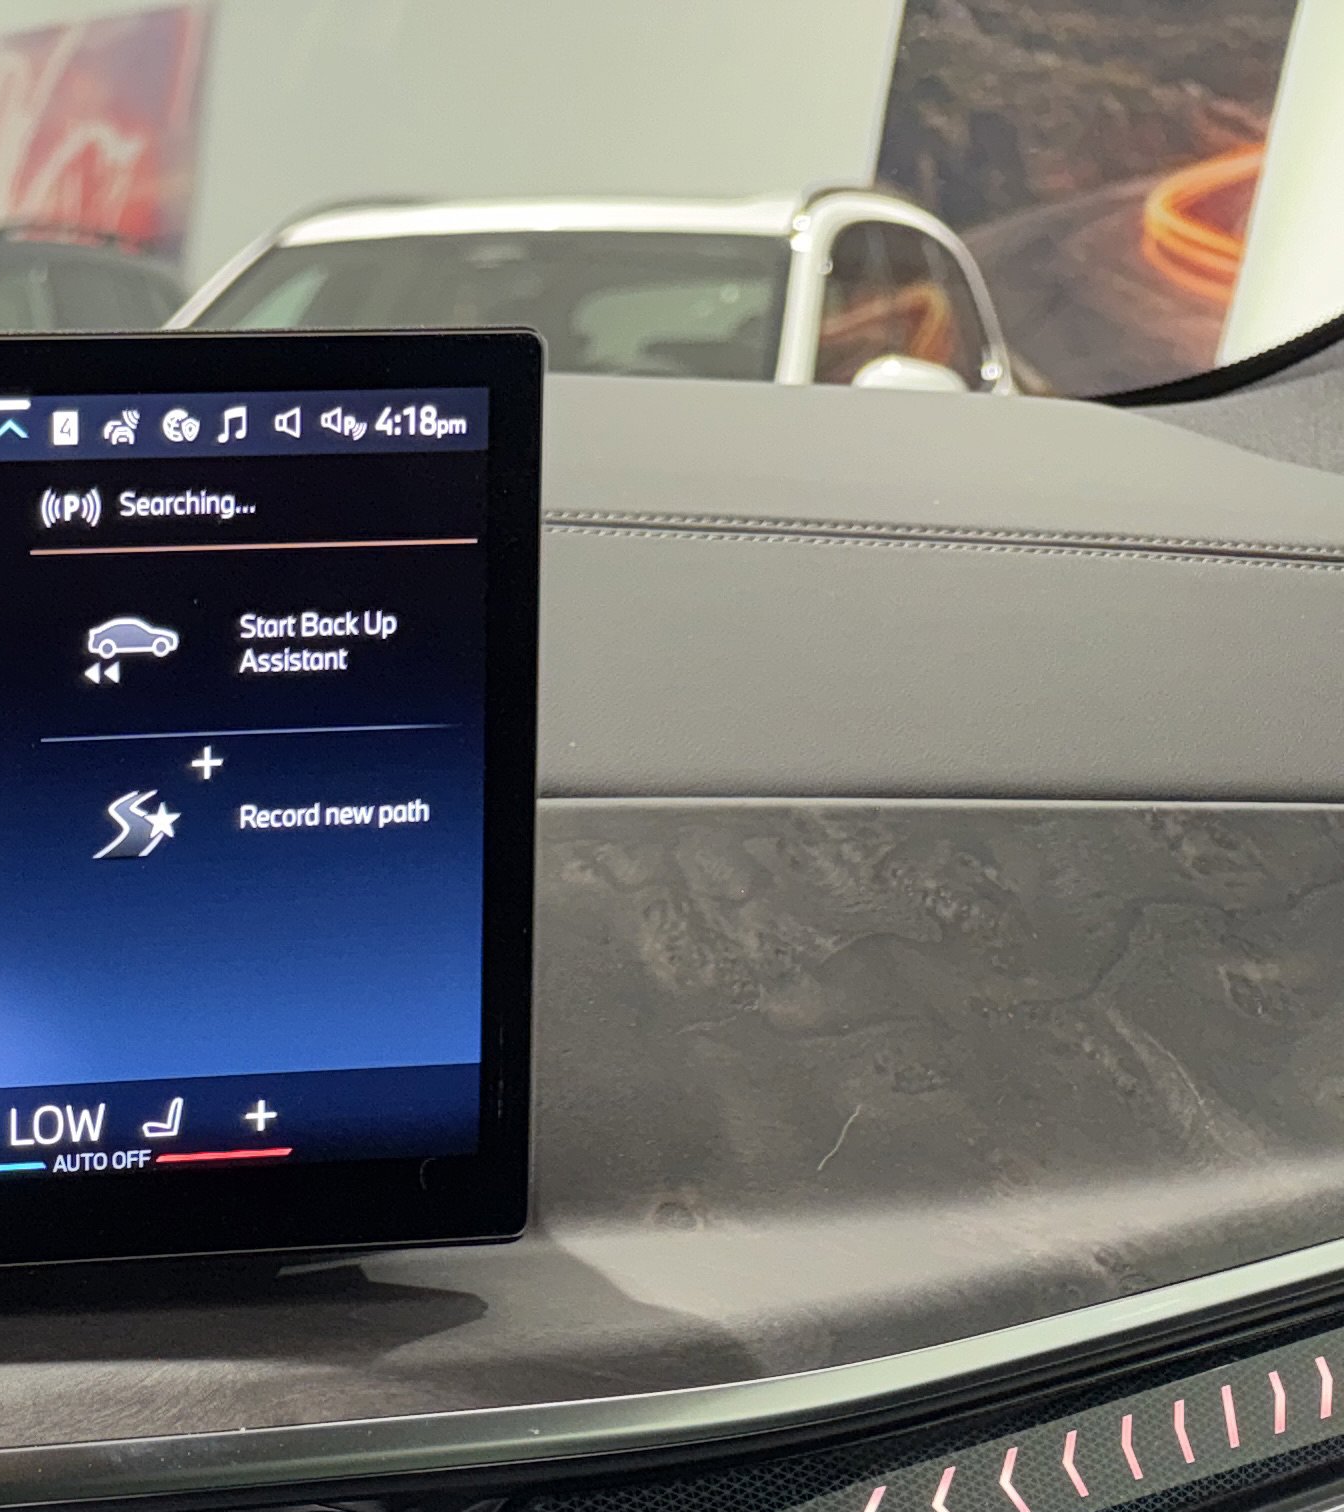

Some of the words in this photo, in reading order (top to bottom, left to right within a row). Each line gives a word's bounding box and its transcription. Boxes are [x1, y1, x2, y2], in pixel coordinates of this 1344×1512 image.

[374, 406, 467, 439] 4:18pm
[118, 489, 256, 520] Searching...
[239, 614, 297, 639] Start
[301, 611, 360, 638] Back
[363, 610, 398, 640] Up
[238, 647, 348, 674] Assistant
[239, 802, 320, 829] Record
[325, 808, 374, 827] new
[378, 798, 430, 830] path
[10, 1102, 106, 1146] LOW
[52, 1152, 108, 1174] AUTO
[112, 1149, 152, 1170] OFF
